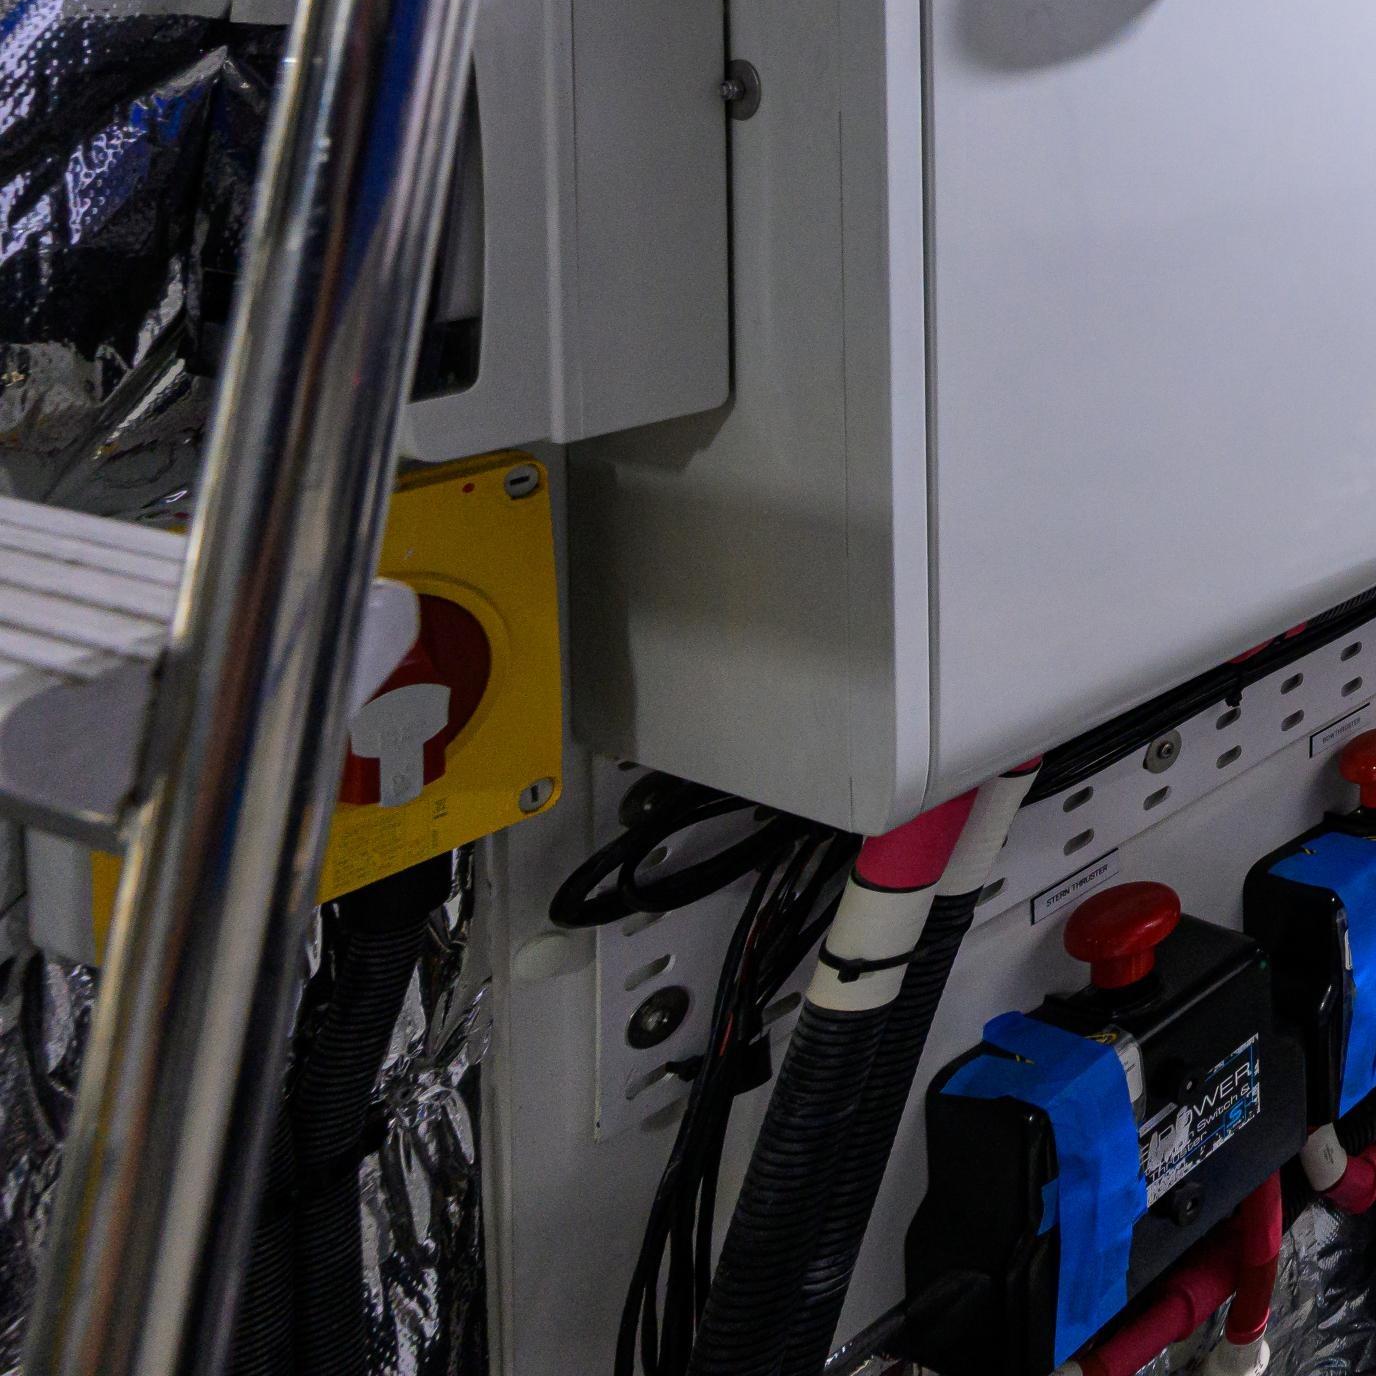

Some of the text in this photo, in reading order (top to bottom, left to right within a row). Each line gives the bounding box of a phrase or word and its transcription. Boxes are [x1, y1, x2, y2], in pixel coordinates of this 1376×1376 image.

[1334, 716, 1362, 739] THRUSTER
[1045, 863, 1109, 909] STERN THRUSTER
[1196, 1093, 1239, 1133] Switch
